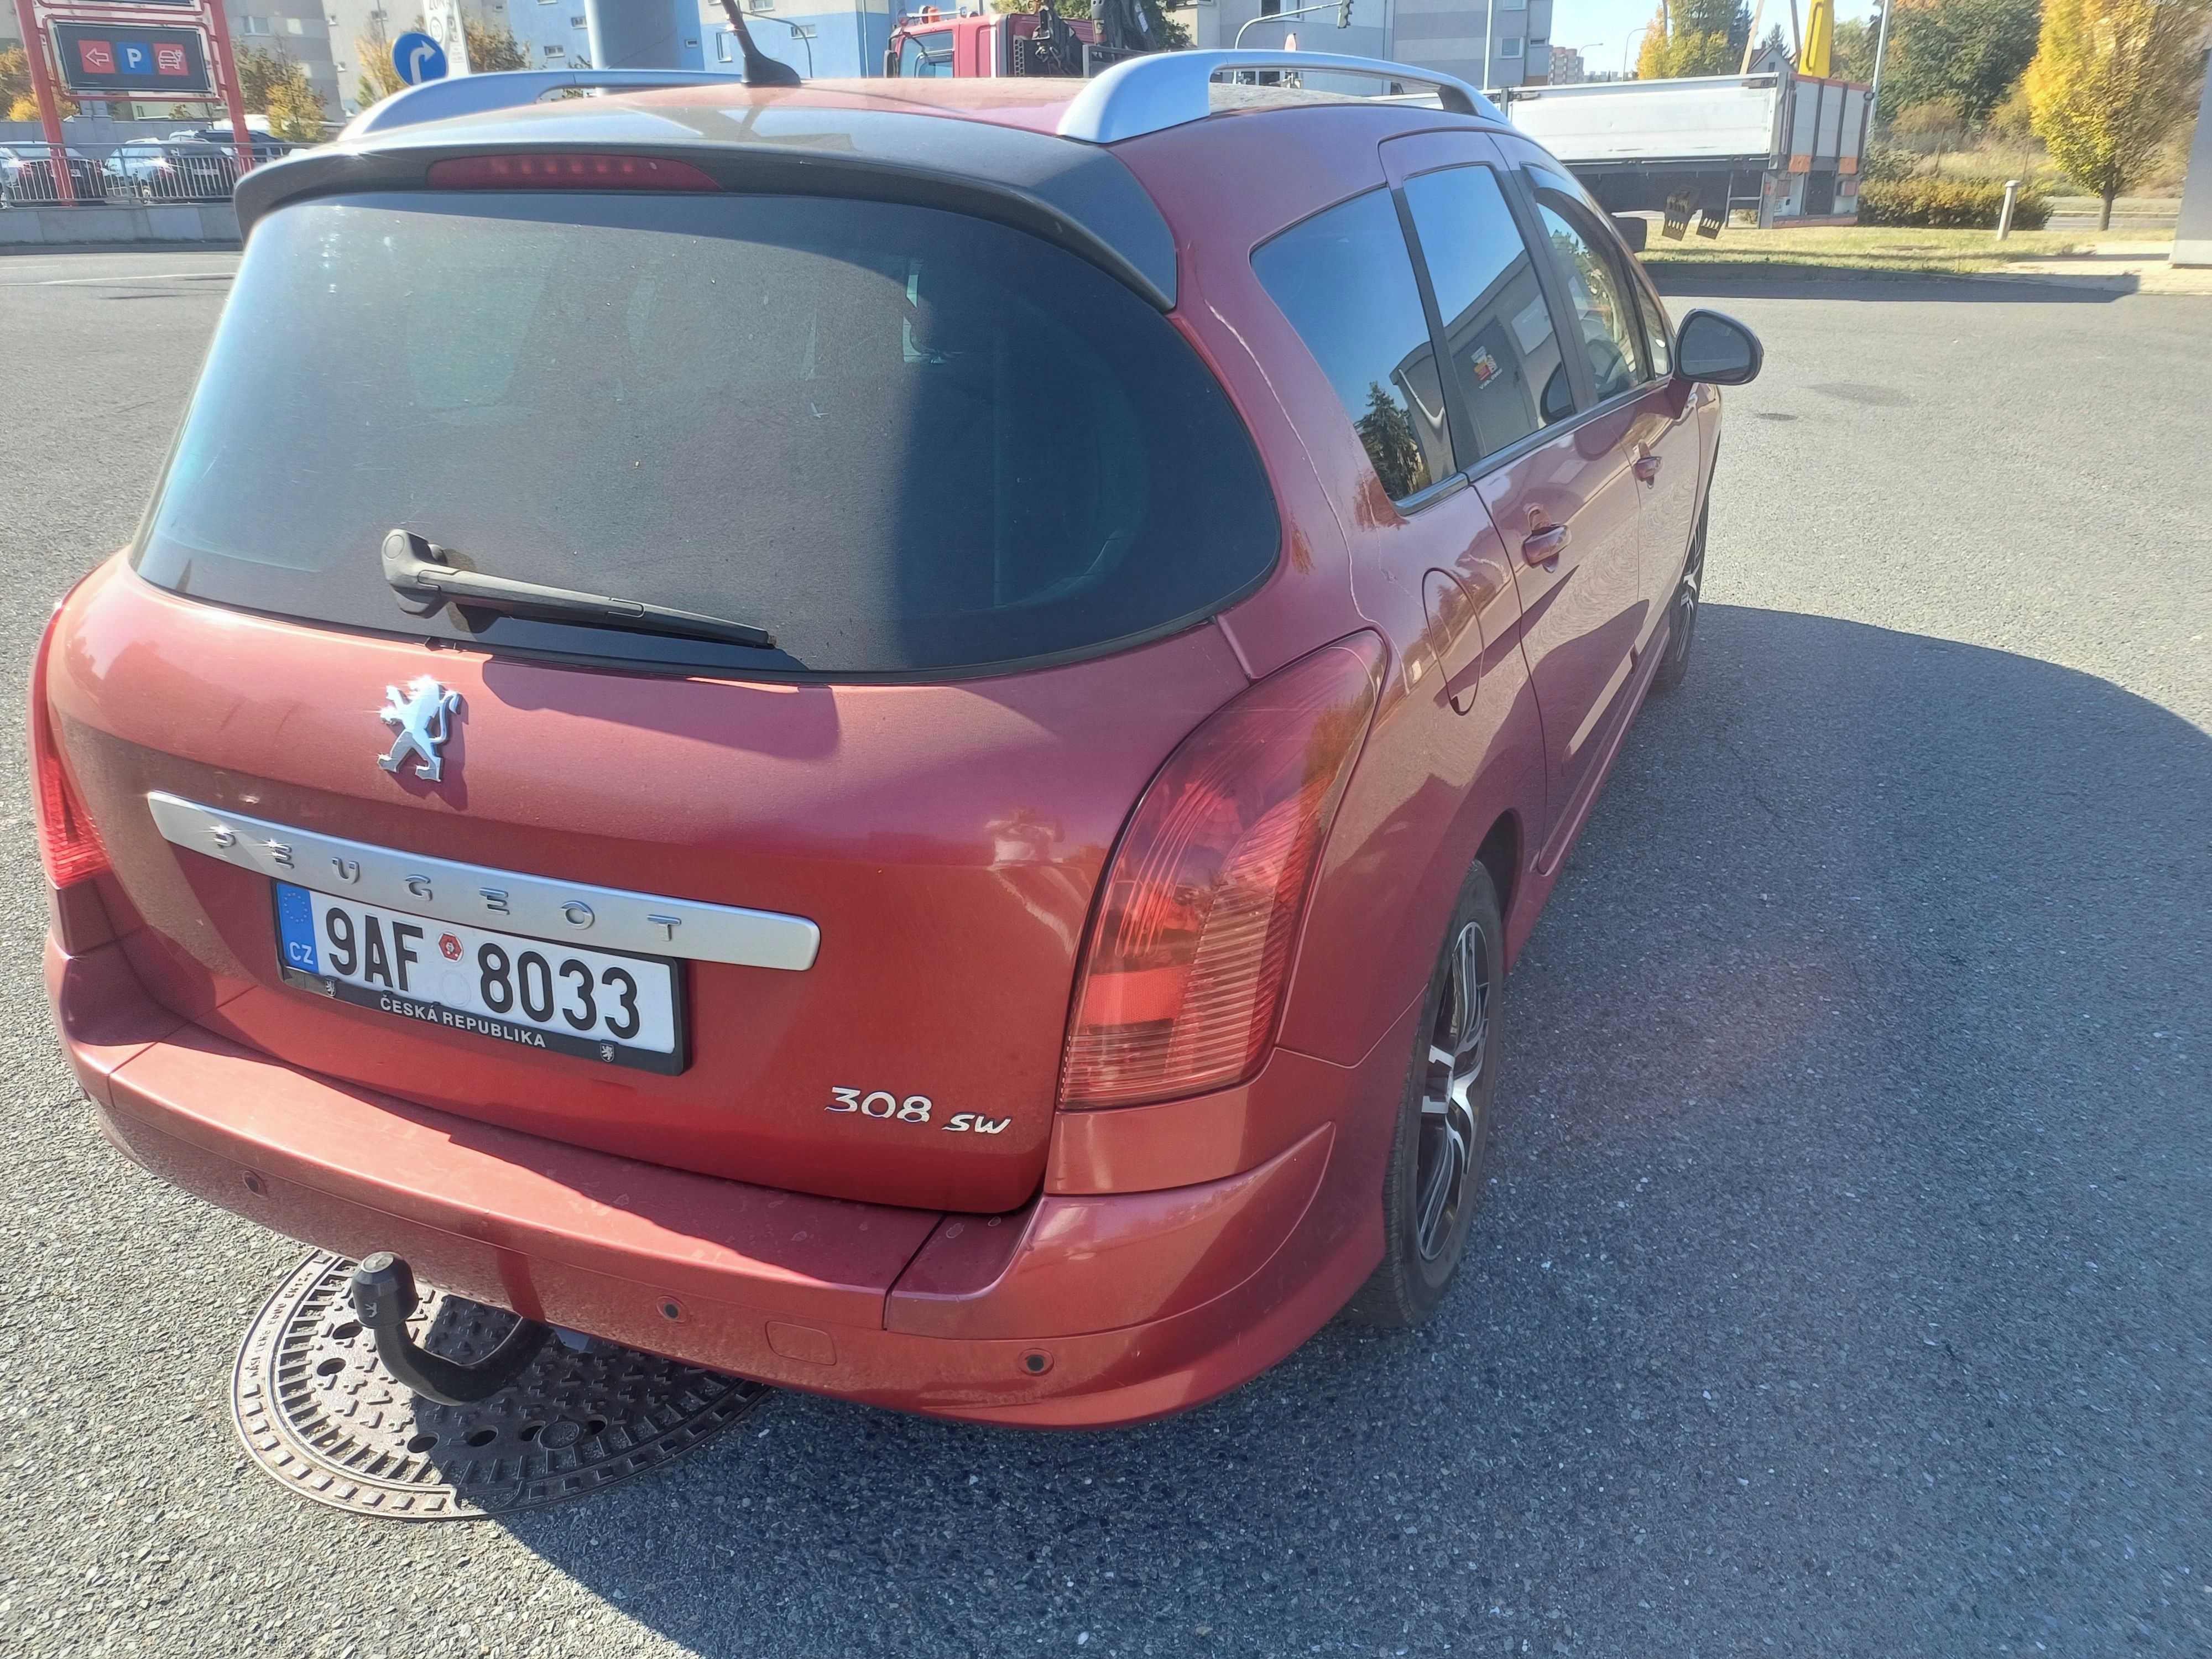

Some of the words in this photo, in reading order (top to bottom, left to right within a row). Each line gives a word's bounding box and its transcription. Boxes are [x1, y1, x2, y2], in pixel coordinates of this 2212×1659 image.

[126, 48, 142, 69] P
[210, 825, 681, 941] PEUGEOT
[289, 941, 314, 965] CZ
[326, 907, 424, 992] 9AF
[478, 943, 640, 1039] 8033
[380, 994, 438, 1022] ČESKÁ
[442, 1011, 546, 1047] REPUBLIKA
[824, 1087, 932, 1123] 308
[941, 1114, 1011, 1134] SW
